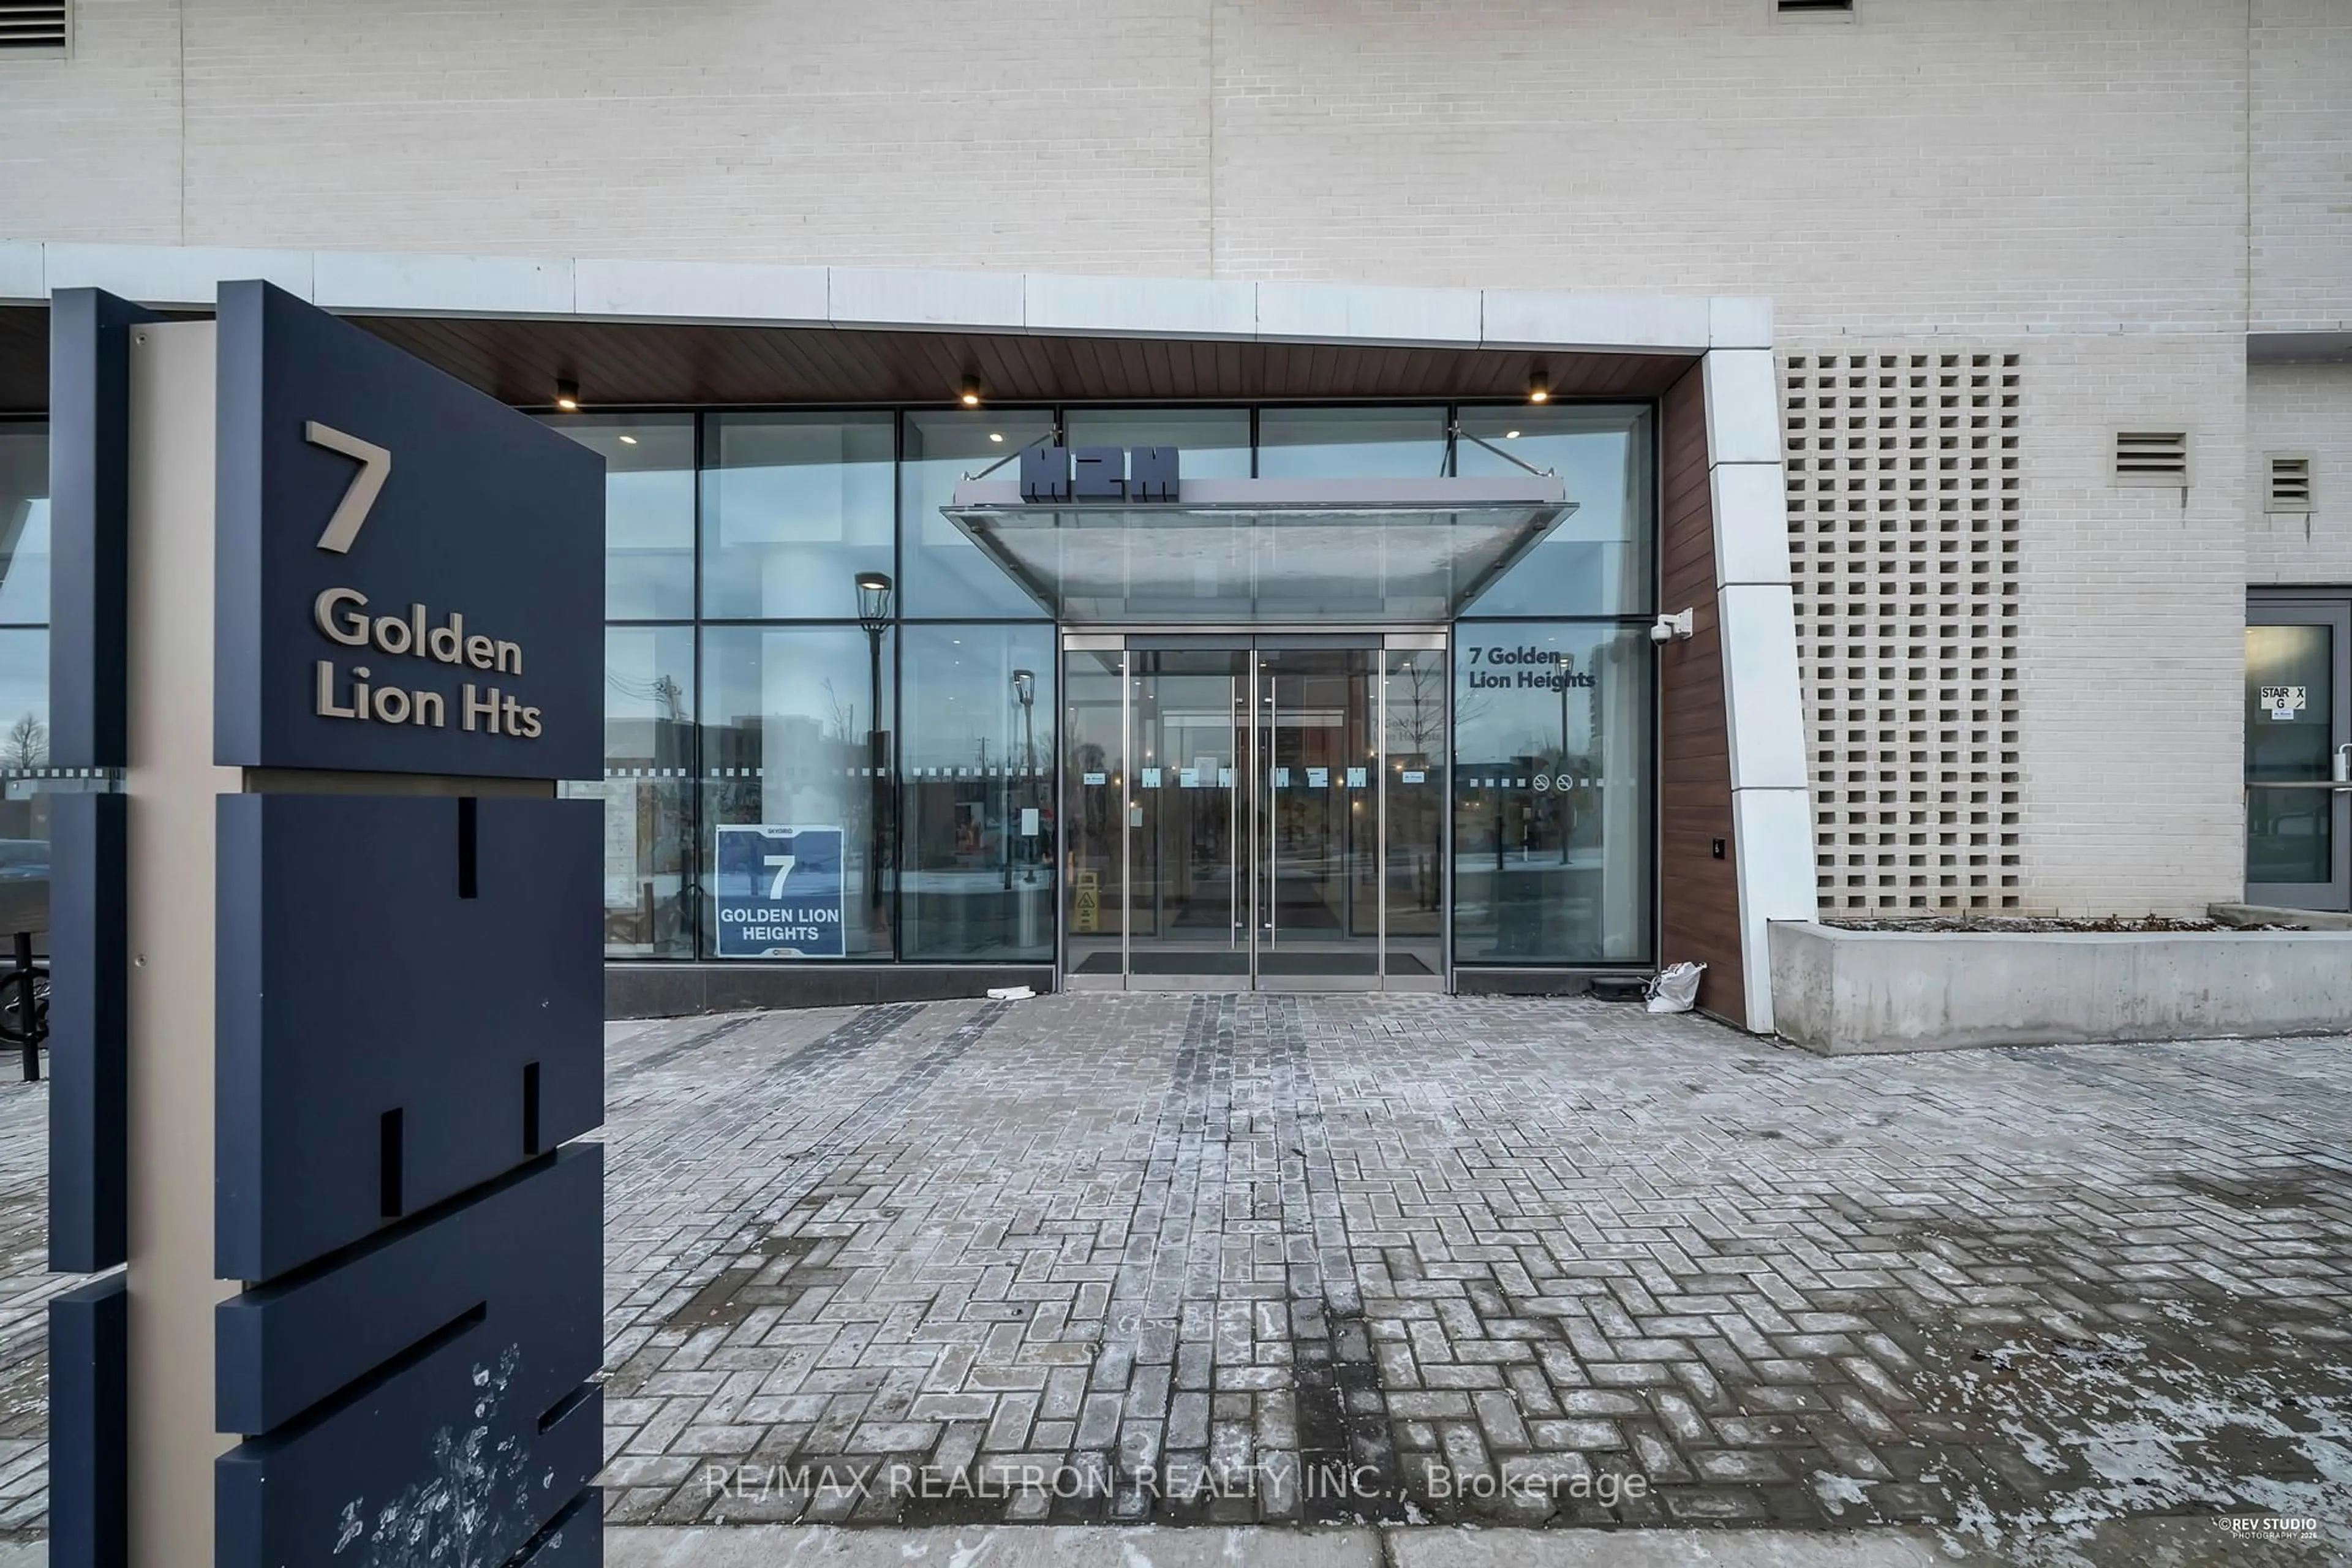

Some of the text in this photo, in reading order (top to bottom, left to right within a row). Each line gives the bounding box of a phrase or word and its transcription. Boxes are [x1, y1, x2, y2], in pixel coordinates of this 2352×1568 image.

[306, 420, 391, 554] 7
[314, 587, 522, 675] Golden
[1469, 646, 1561, 665] 7 Golden
[1469, 670, 1596, 693] Lion Heights
[316, 660, 542, 738] Lion Hts
[2263, 688, 2304, 698] STAIR X
[2277, 699, 2284, 708] G
[764, 855, 795, 900] 7
[721, 909, 839, 922] GOLDEN LION
[742, 927, 819, 941] HEIGHTS
